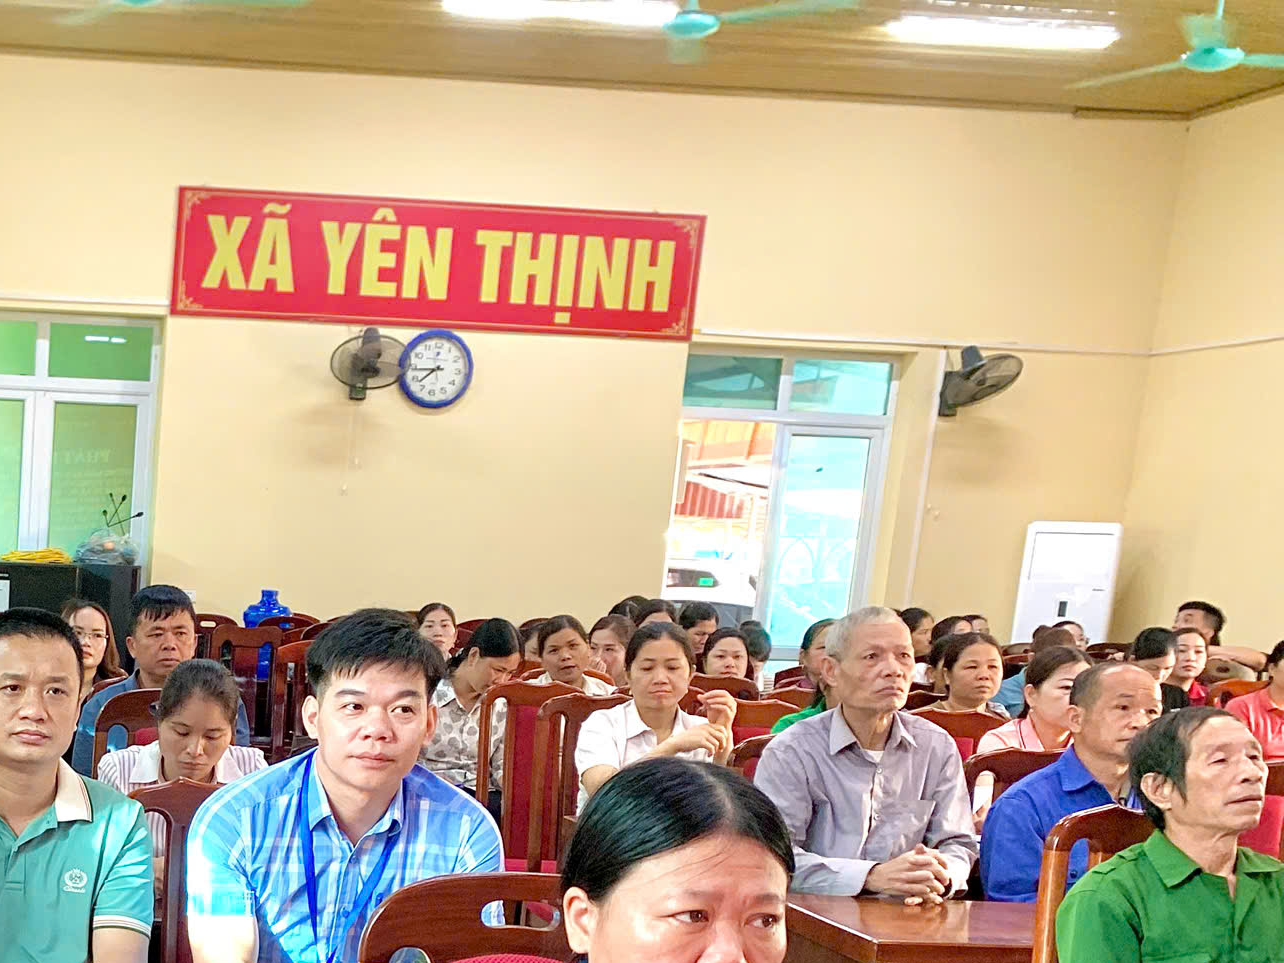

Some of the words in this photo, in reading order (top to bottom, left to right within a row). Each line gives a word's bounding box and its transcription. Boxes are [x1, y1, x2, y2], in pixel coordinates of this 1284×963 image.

[201, 202, 294, 293] XÃ
[321, 208, 453, 300] YÊN
[476, 229, 677, 323] THỊNH
